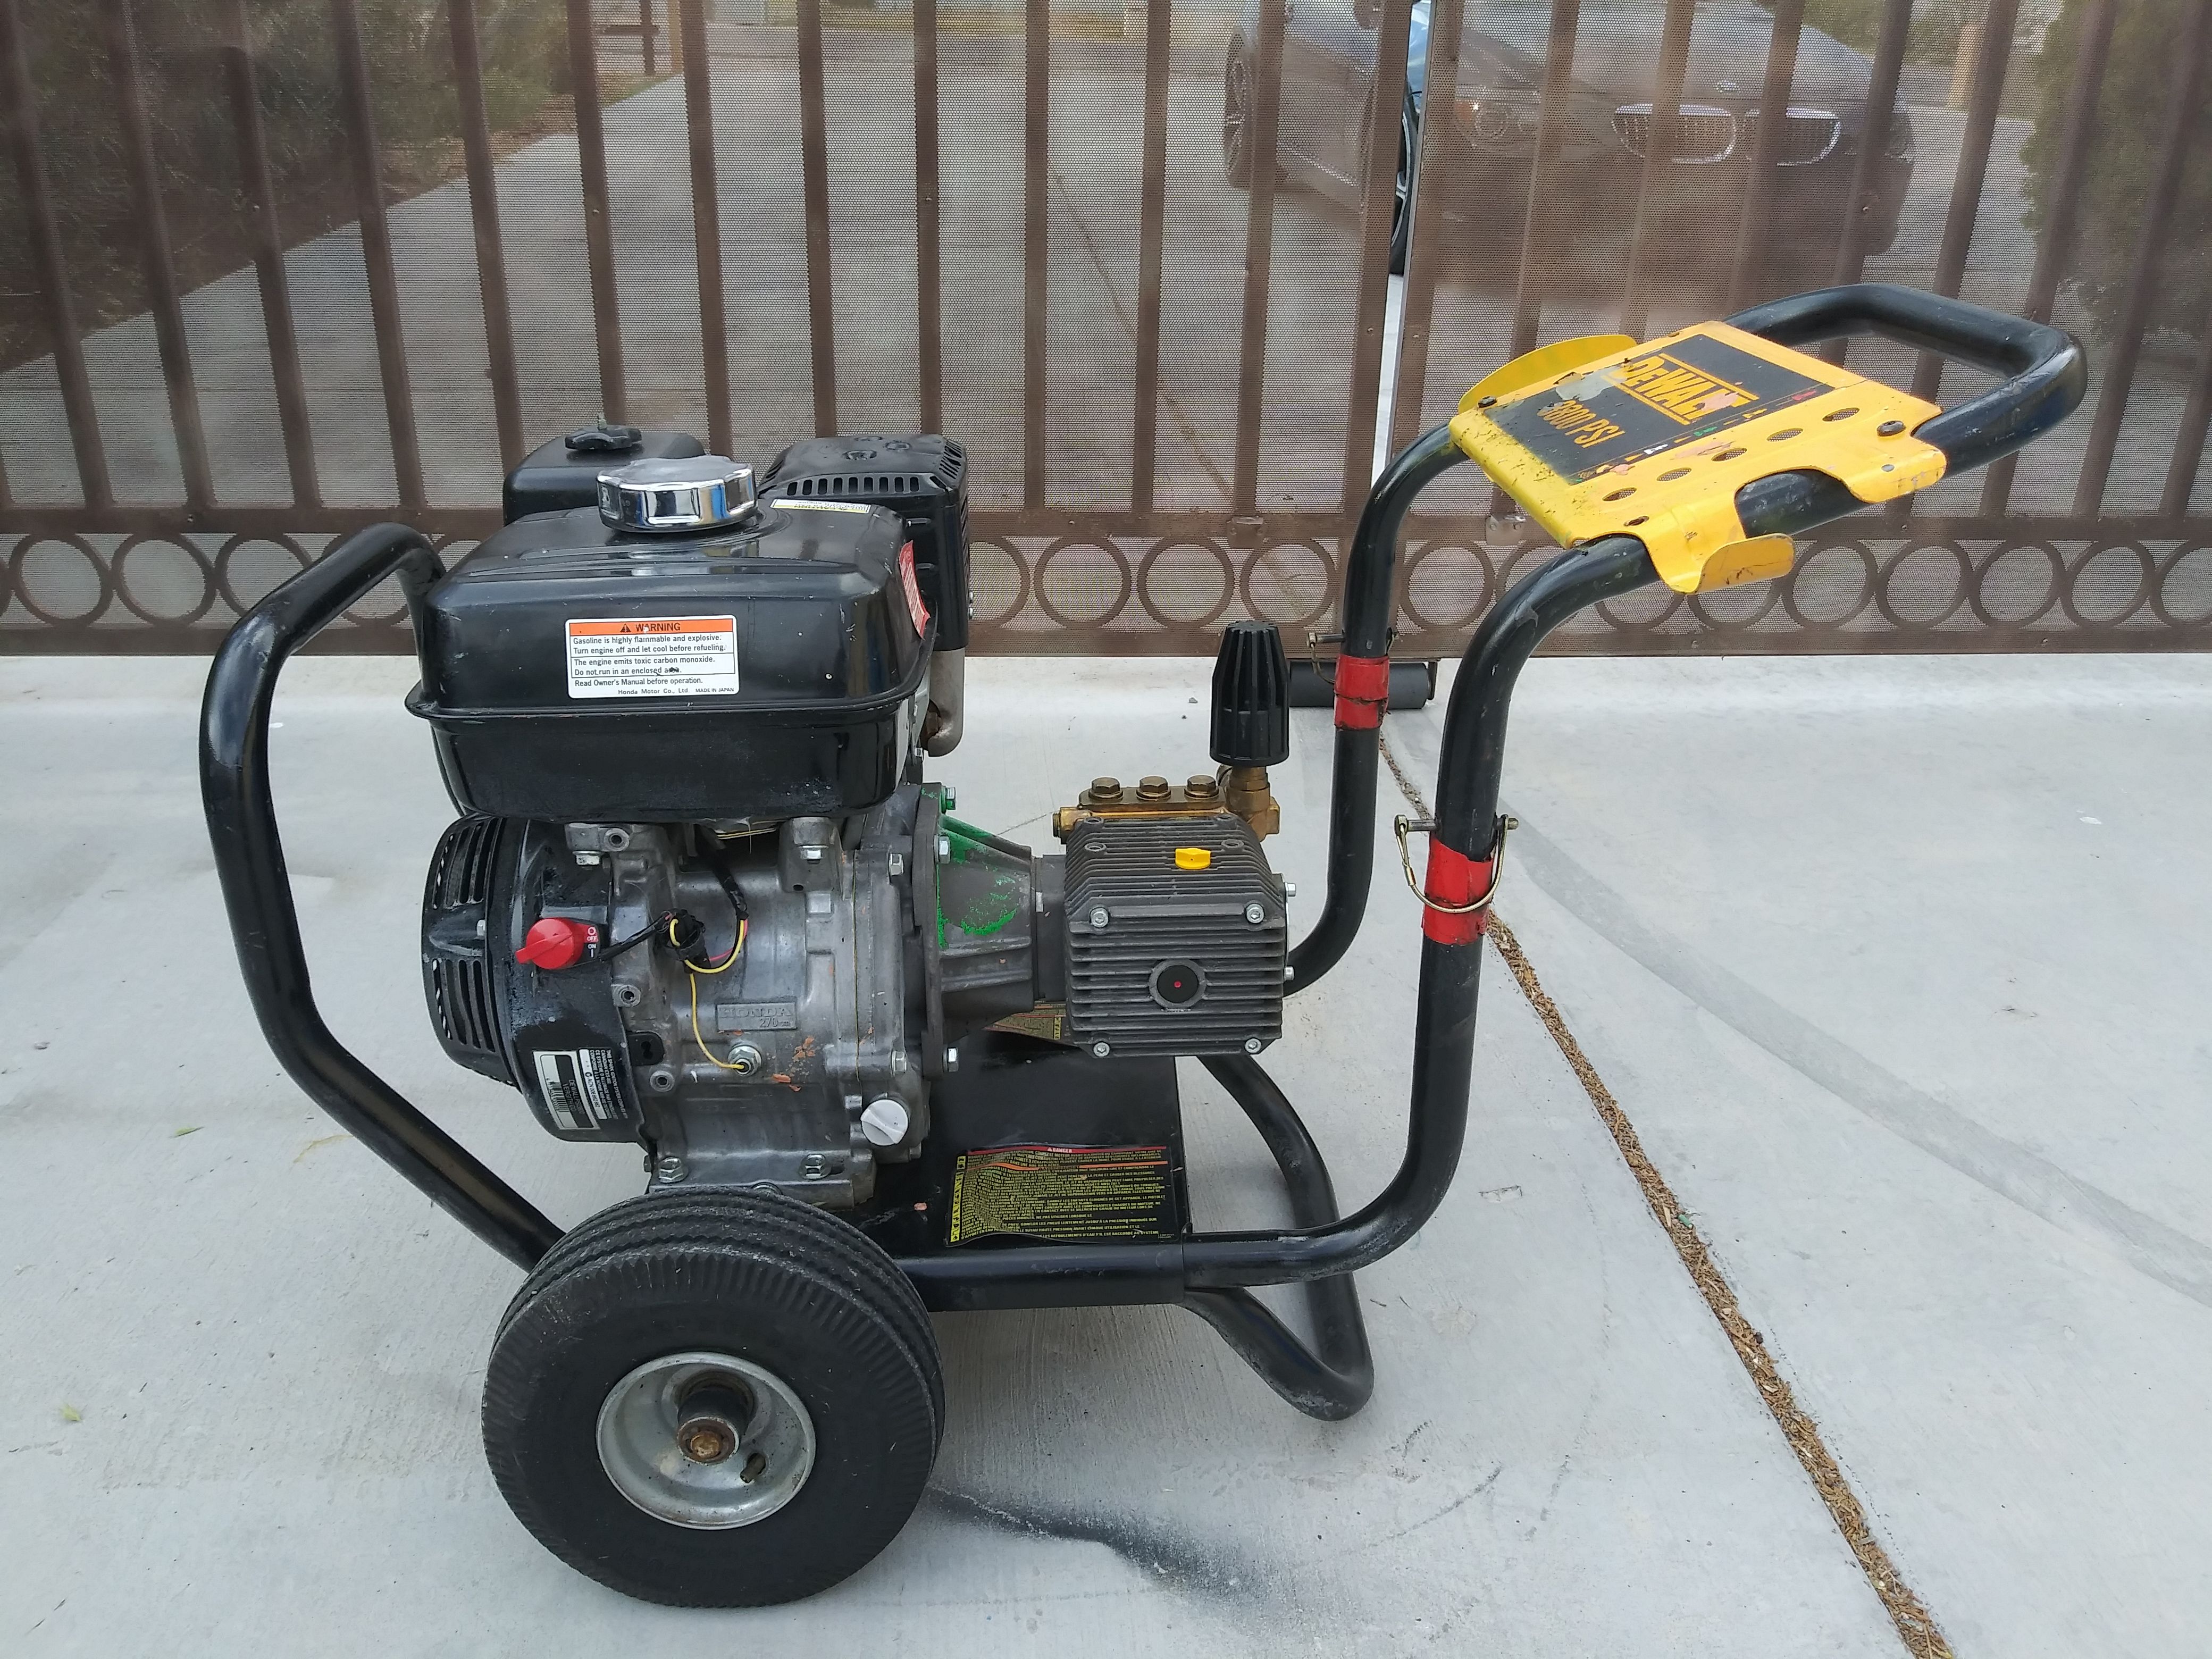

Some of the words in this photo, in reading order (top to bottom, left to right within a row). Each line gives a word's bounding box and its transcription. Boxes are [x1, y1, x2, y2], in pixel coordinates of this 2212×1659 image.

[1565, 418, 1626, 448] PSI
[635, 622, 681, 632] WARNING
[719, 1007, 792, 1018] HONDA
[759, 1017, 778, 1028] 270
